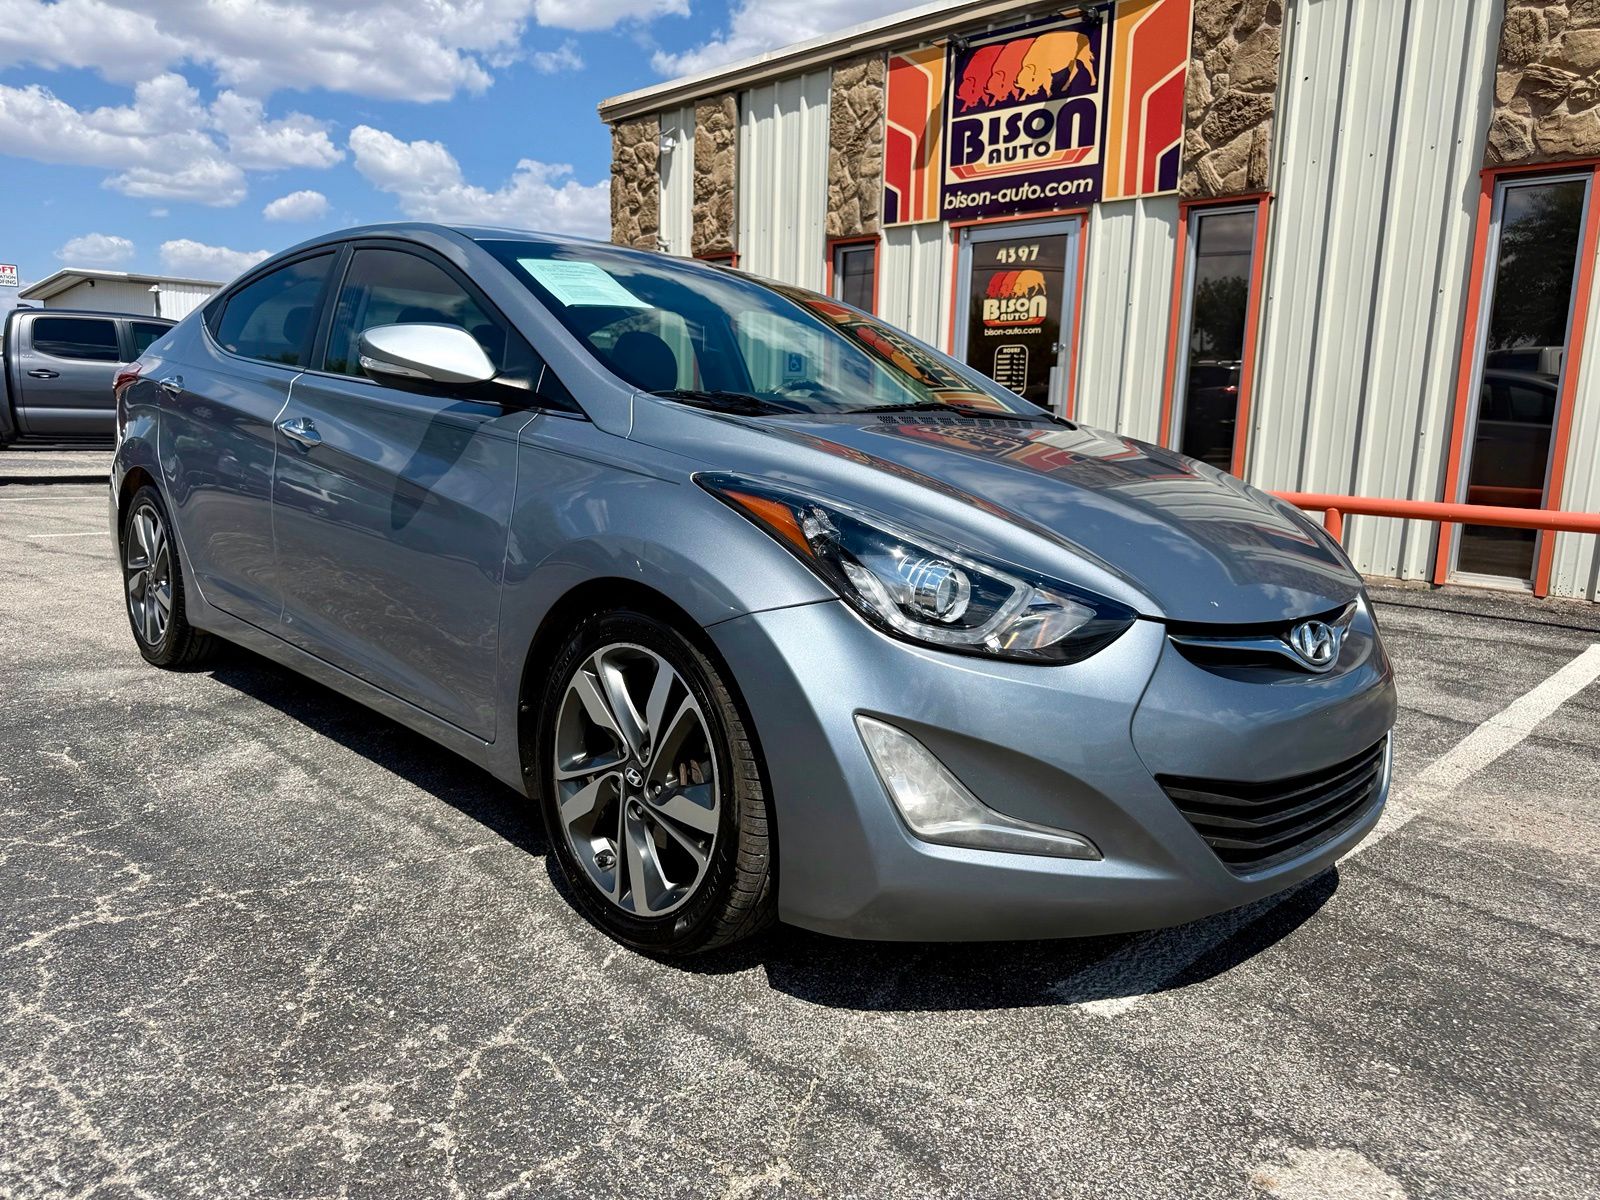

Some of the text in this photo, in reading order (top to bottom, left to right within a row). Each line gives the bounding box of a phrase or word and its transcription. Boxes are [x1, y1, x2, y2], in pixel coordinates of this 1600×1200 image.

[950, 97, 1097, 166] BISON
[988, 140, 1051, 164] AUTO
[944, 176, 1093, 210] bison-auto.com
[996, 244, 1040, 264] 4397
[0, 266, 15, 274] FT
[983, 295, 1047, 321] BISON
[1000, 312, 1028, 321] AUTO
[984, 327, 1042, 336] bison-auto.com
